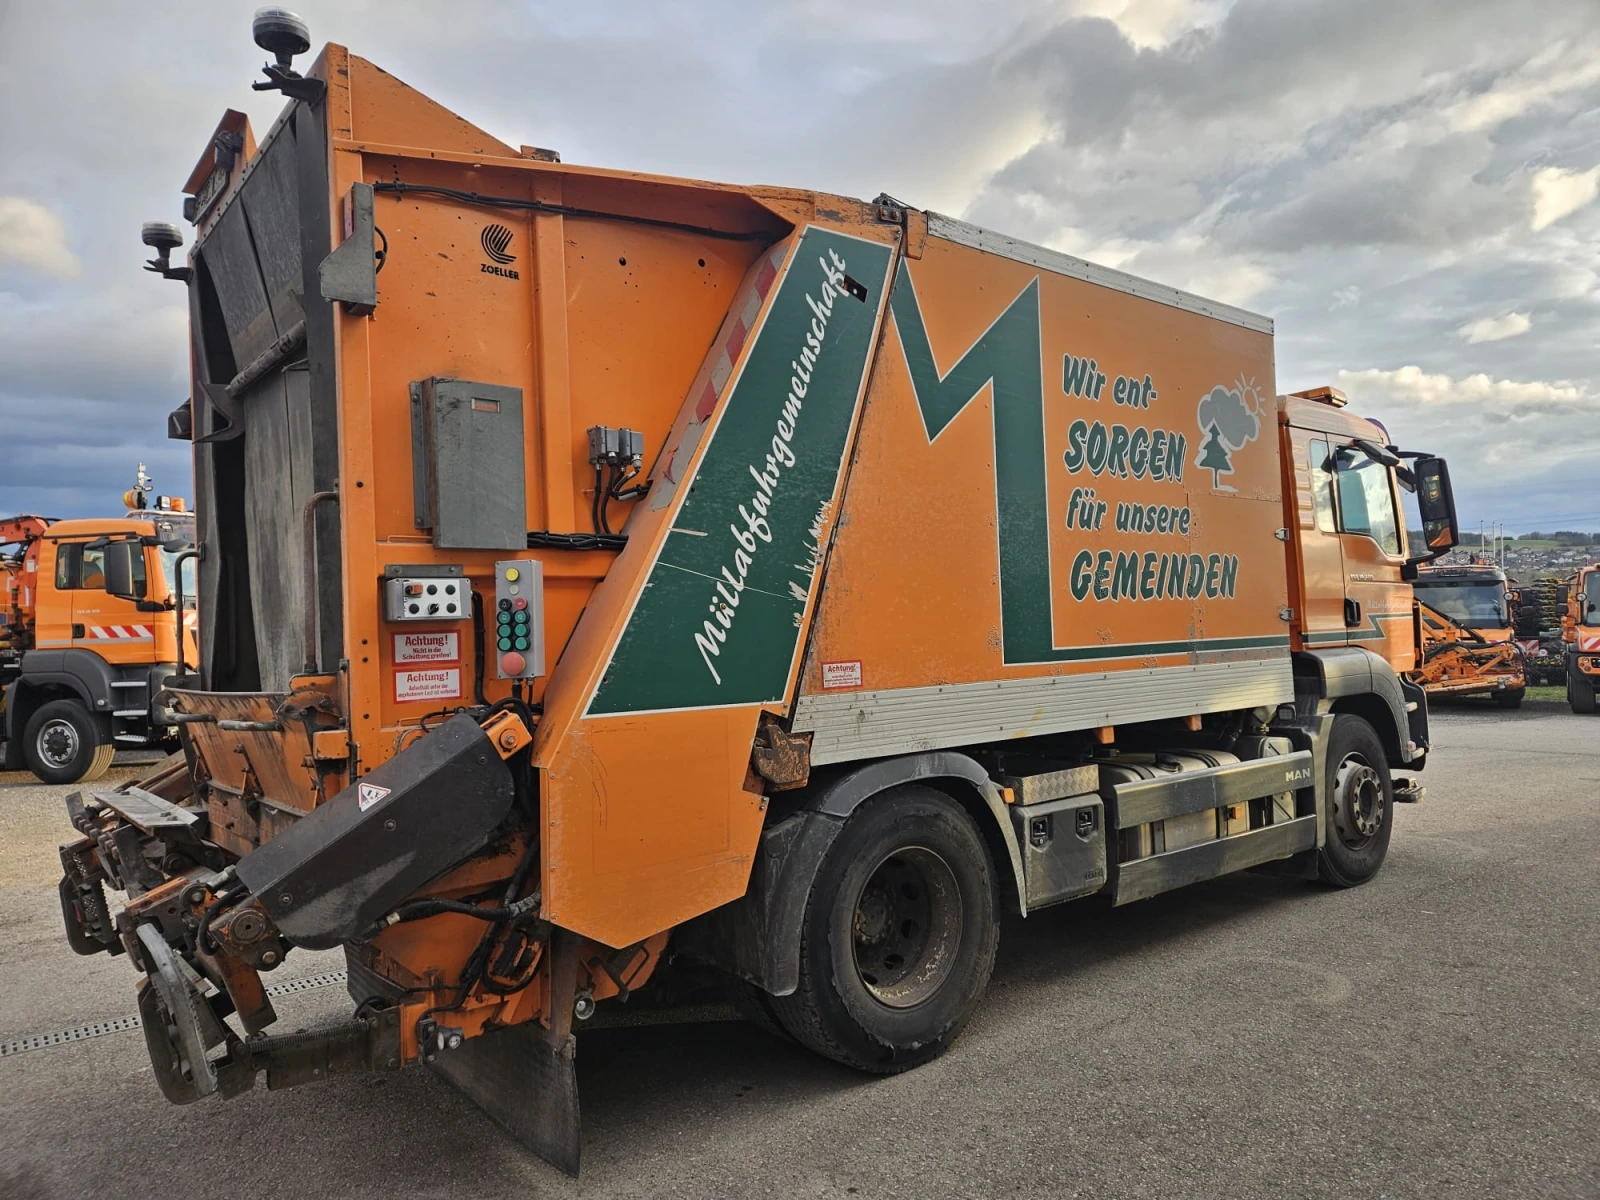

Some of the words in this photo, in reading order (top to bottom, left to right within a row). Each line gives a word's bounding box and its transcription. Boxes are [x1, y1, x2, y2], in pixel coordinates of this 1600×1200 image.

[481, 263, 520, 280] ZOELLER
[1062, 353, 1107, 402] Wir
[1112, 373, 1158, 410] ent-
[693, 247, 847, 686] Müllabfuhrgemeinschaft
[1063, 418, 1187, 484] SORGEN
[1065, 487, 1108, 532] für
[1115, 501, 1191, 535] unsere
[1069, 547, 1240, 603] GEMEINDEN
[405, 635, 448, 647] Achtung!
[407, 672, 448, 682] Achtung!
[828, 664, 856, 672] Achtung!
[1285, 766, 1311, 783] MAN
